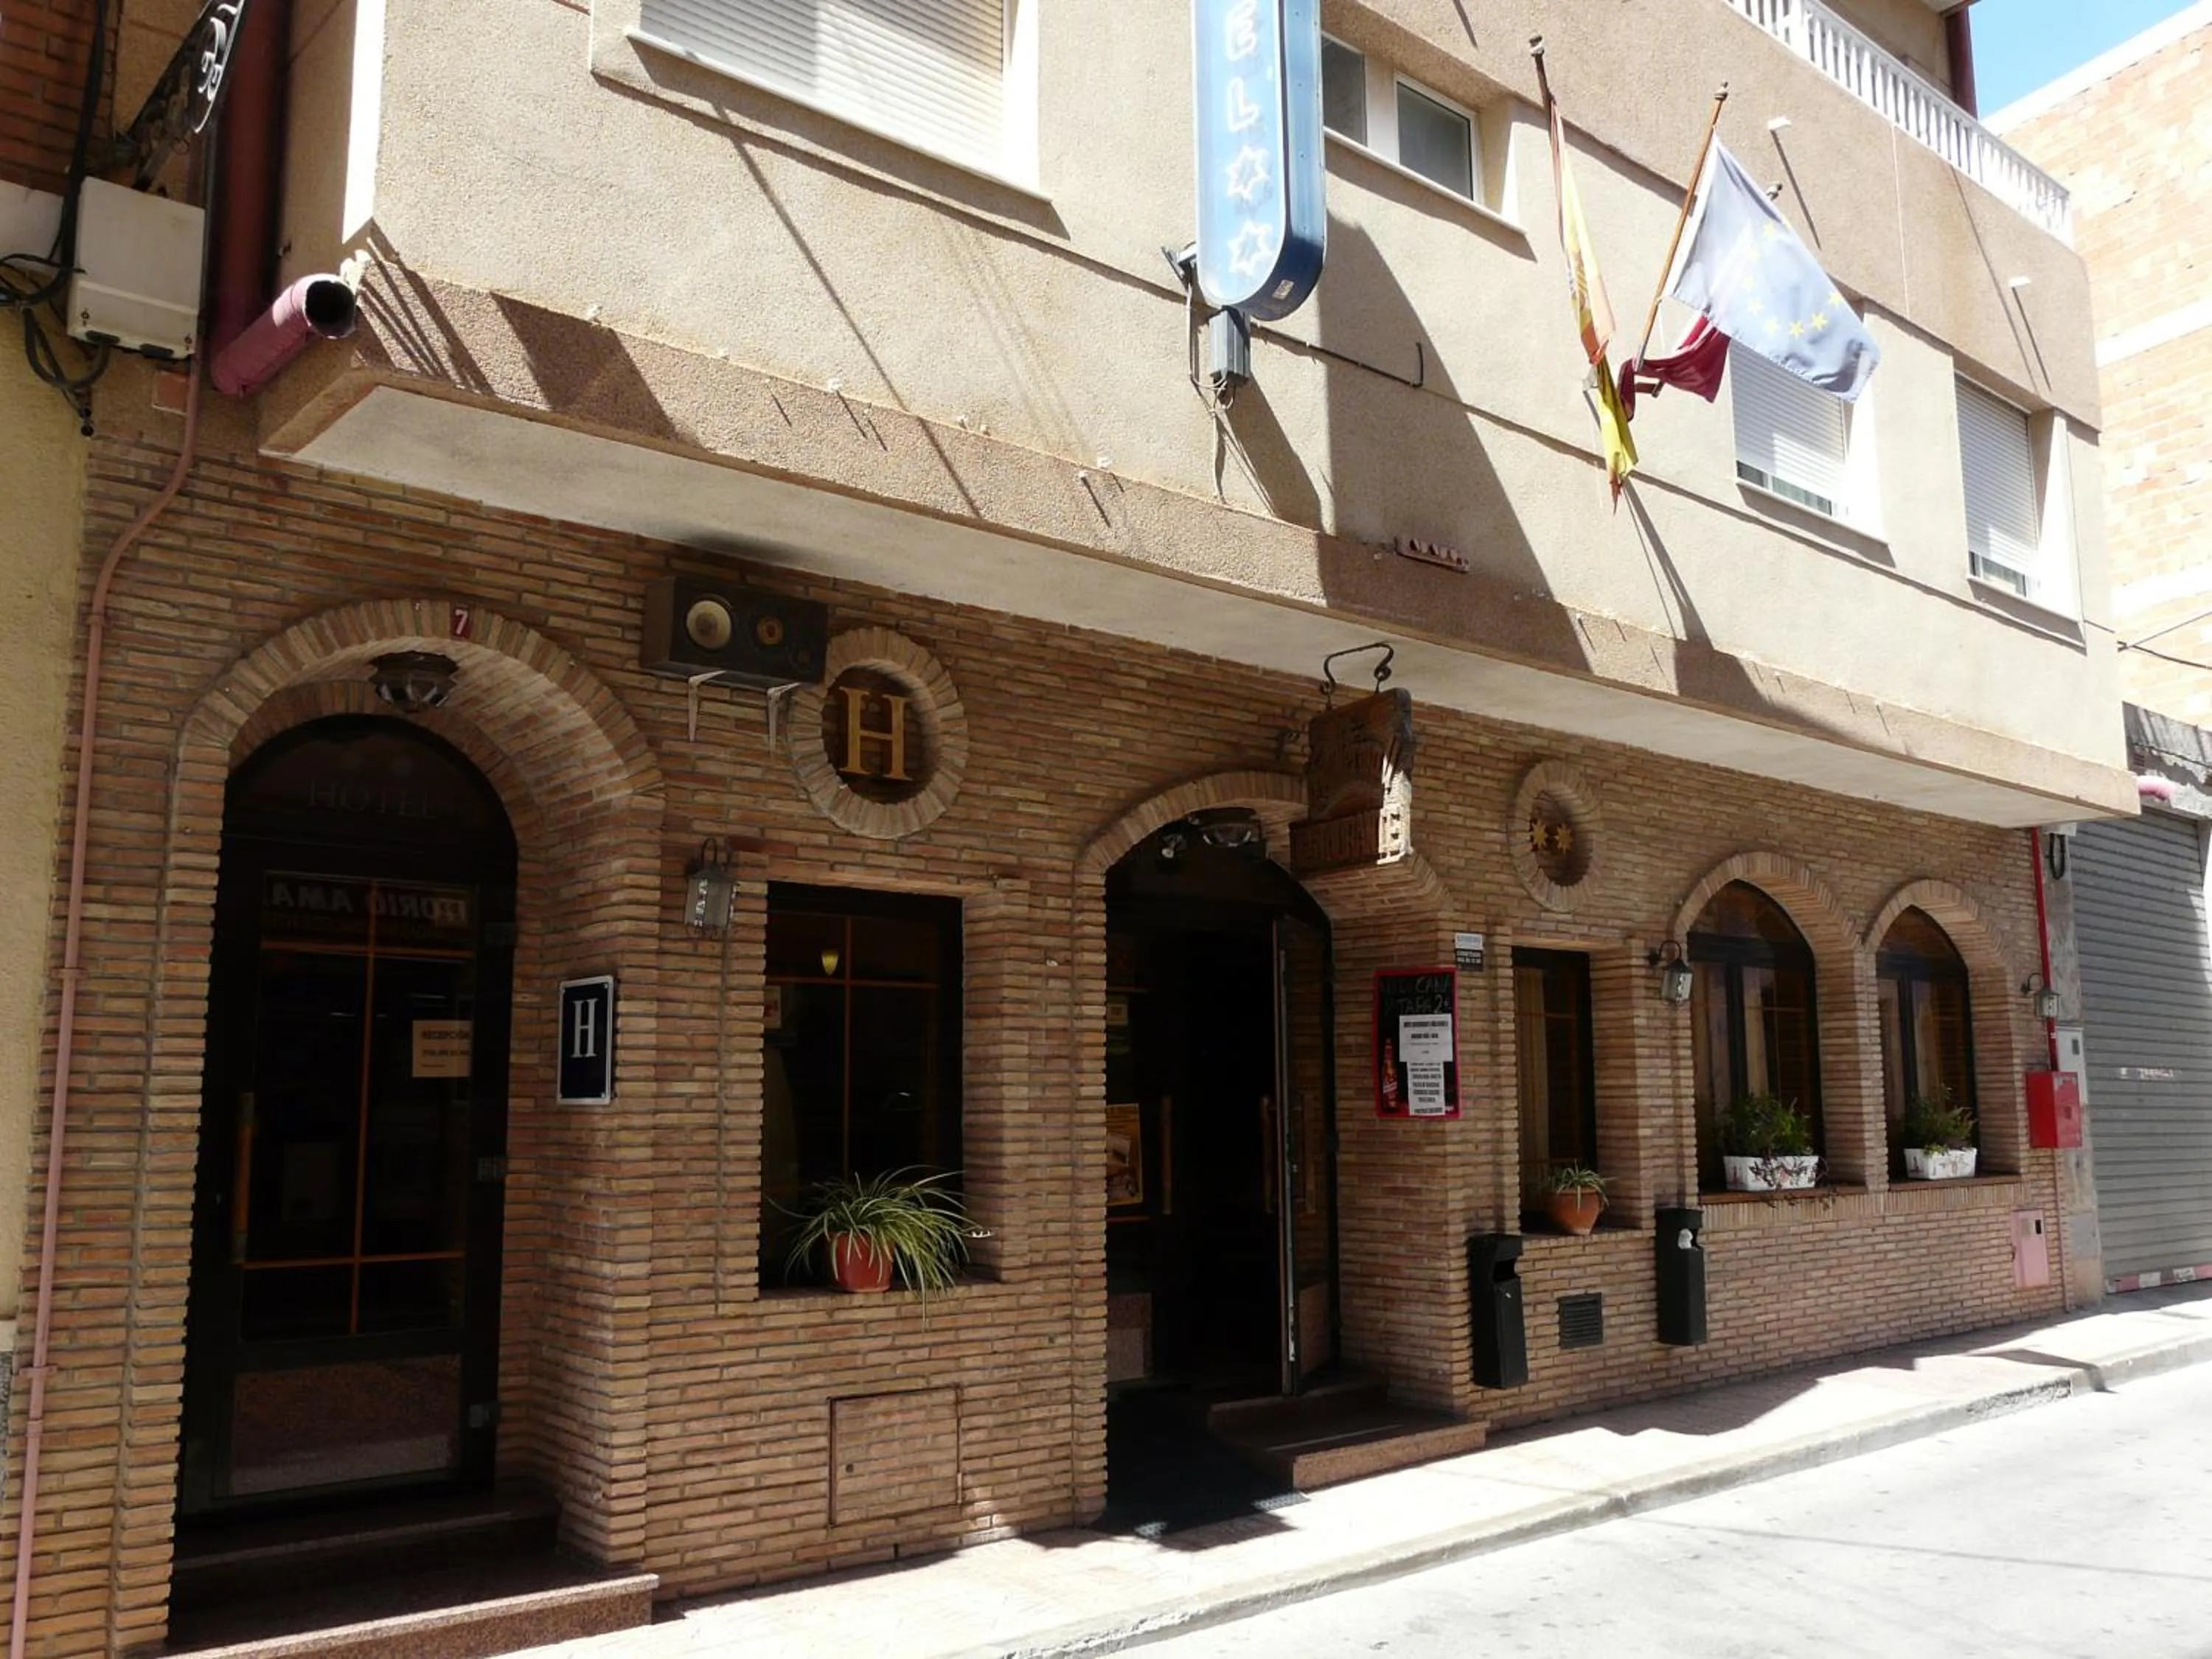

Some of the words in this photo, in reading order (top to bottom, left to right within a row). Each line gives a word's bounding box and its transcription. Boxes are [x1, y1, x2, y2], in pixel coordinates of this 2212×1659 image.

[455, 608, 468, 635] 7
[838, 685, 914, 781] H
[569, 996, 599, 1060] H
